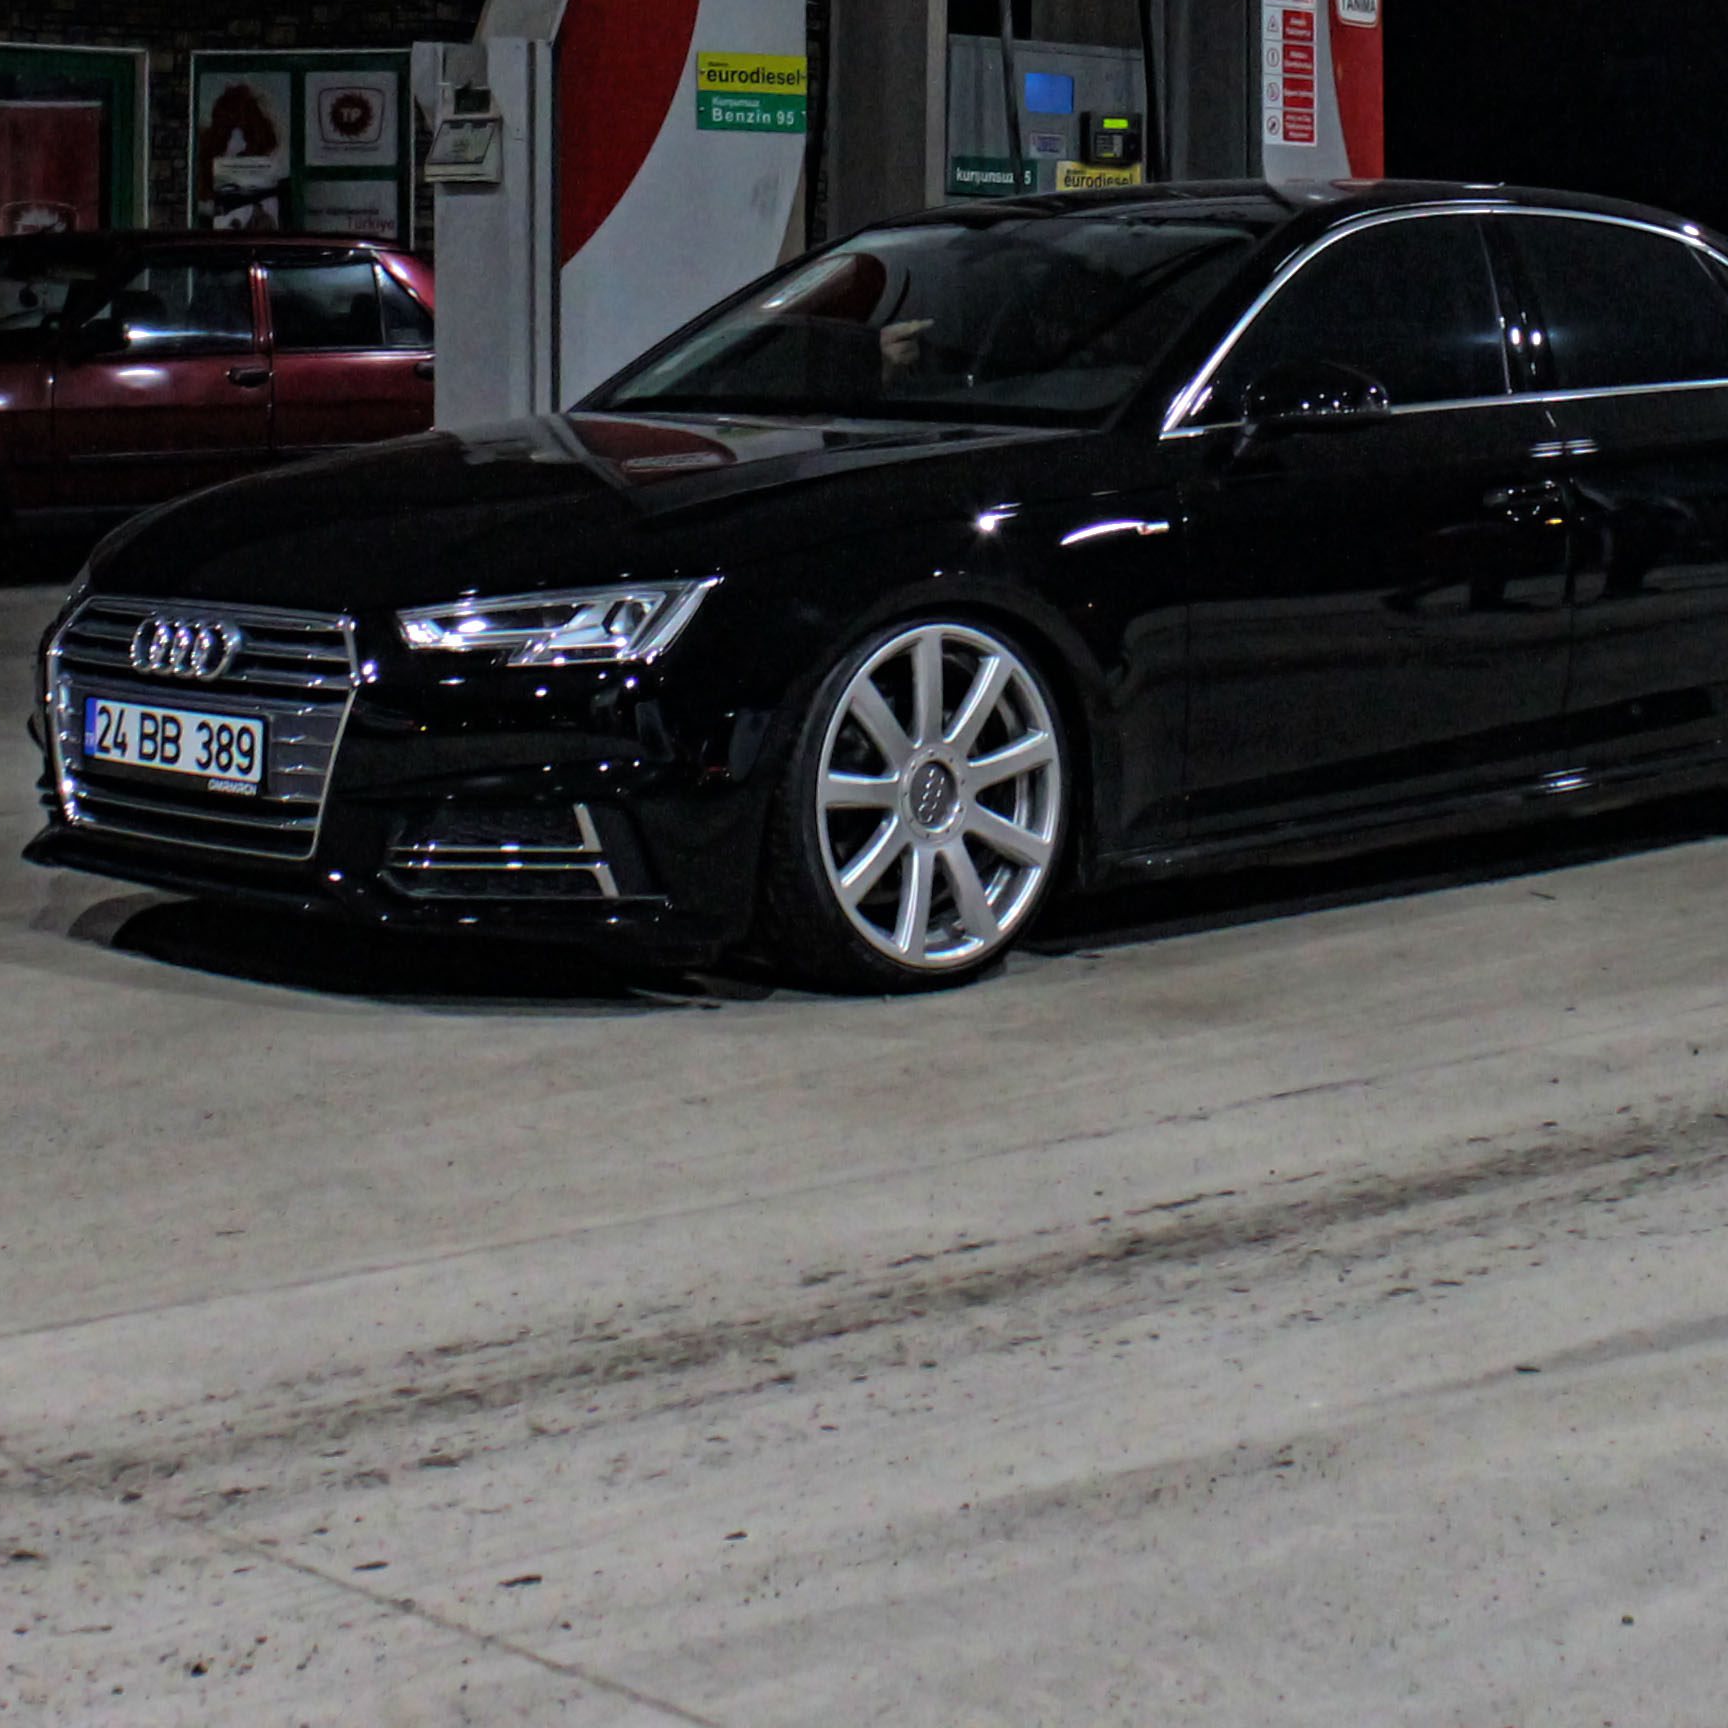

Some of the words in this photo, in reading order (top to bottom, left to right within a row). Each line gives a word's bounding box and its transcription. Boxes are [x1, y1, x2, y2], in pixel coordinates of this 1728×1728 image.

[707, 67, 801, 86] eurodiesel
[711, 107, 772, 123] Benzin
[776, 109, 795, 126] 95
[1064, 173, 1133, 188] eurodiesel
[96, 705, 128, 757] 24
[138, 712, 181, 765] BB
[195, 720, 255, 776] 389
